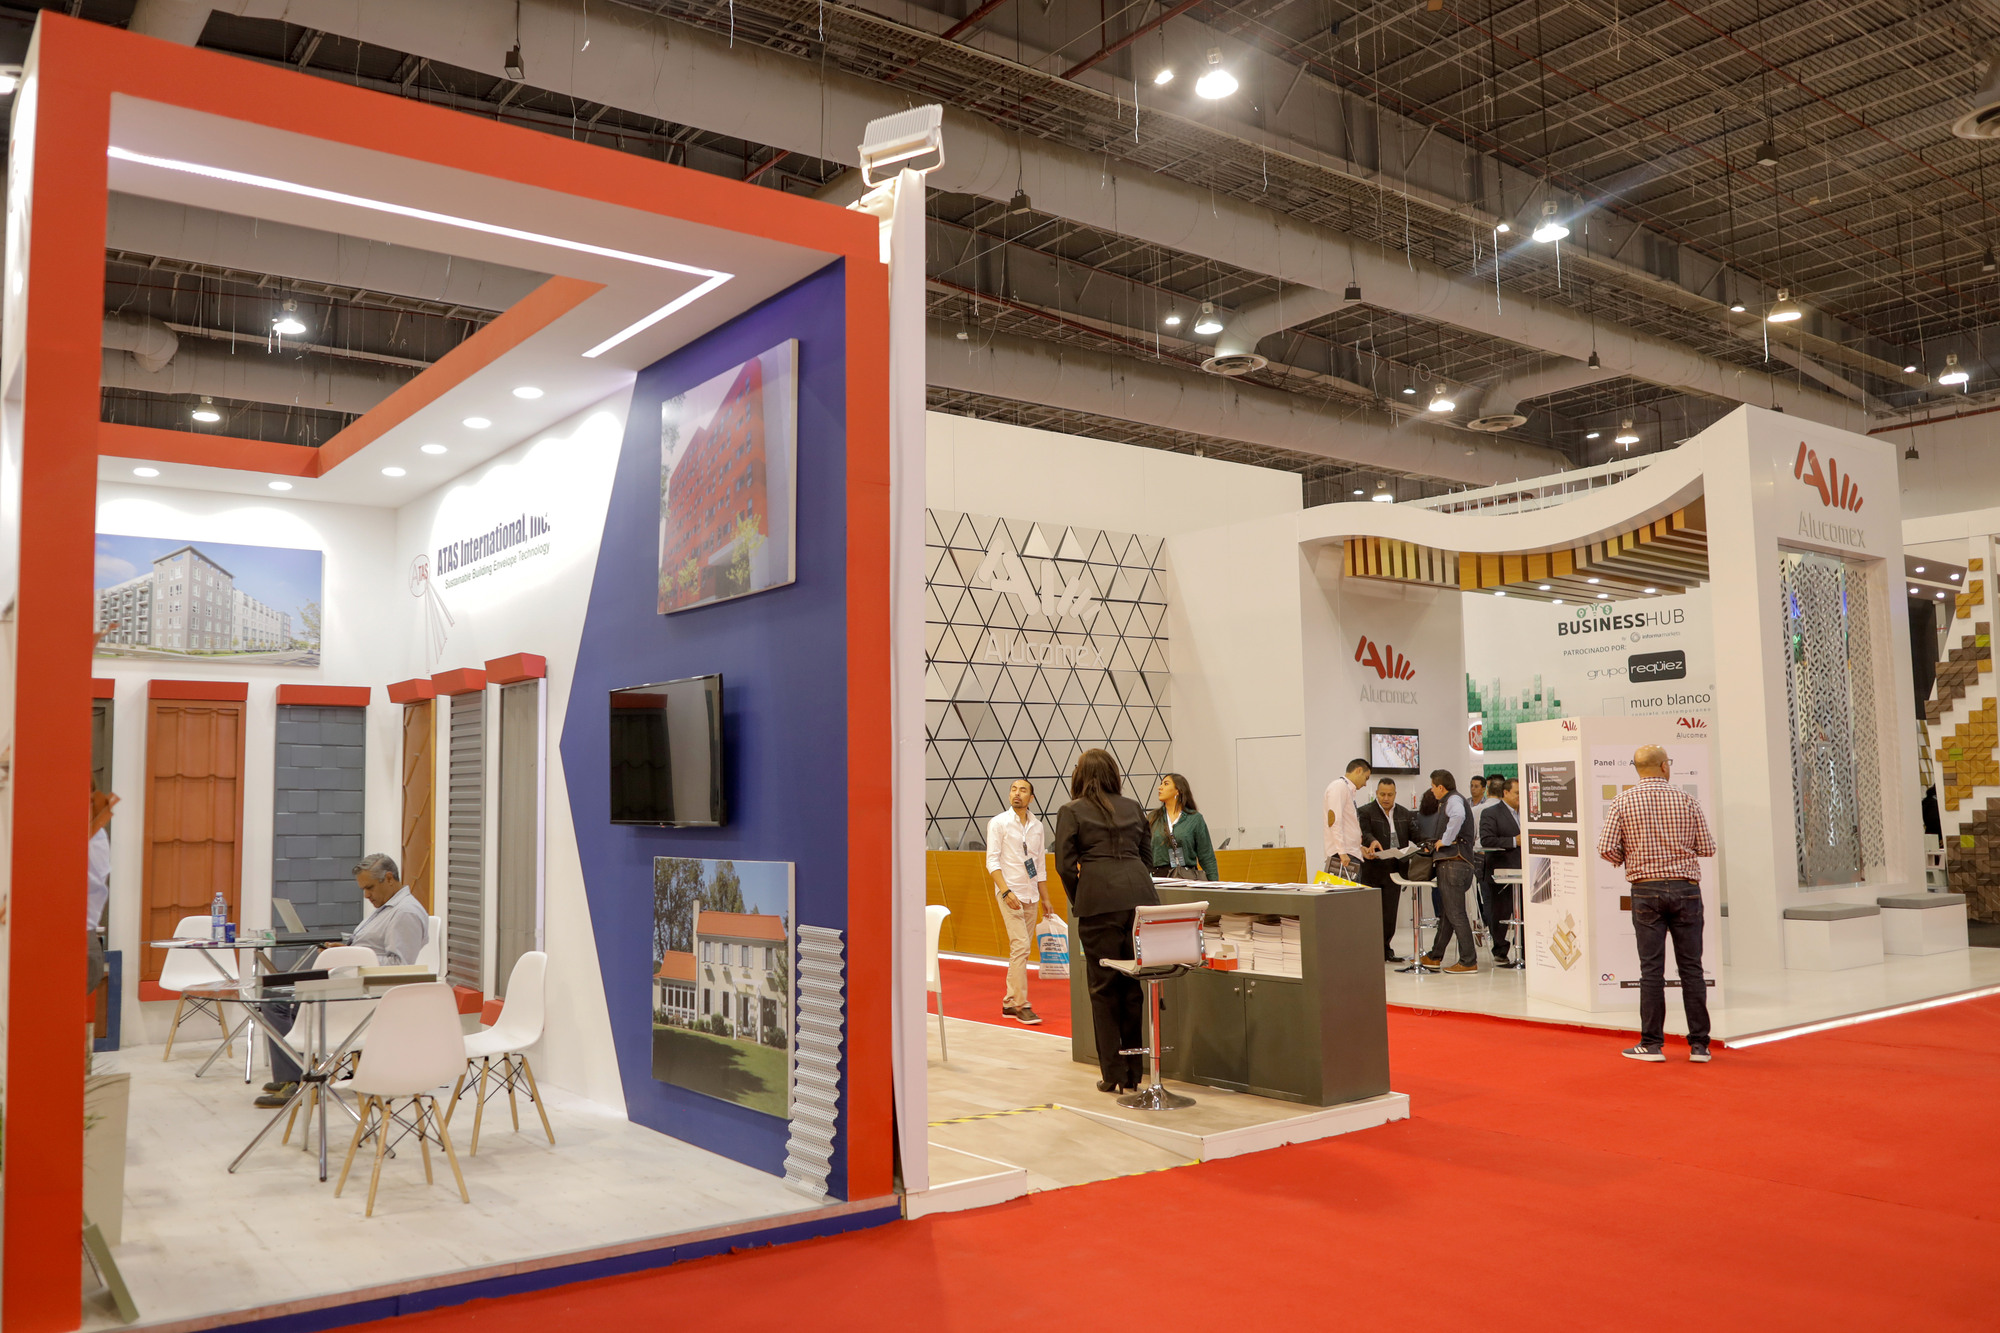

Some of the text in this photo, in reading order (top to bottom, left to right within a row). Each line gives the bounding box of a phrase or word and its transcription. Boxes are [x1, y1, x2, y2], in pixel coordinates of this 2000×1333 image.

[1798, 511, 1866, 549] Alucomex
[437, 541, 459, 576] ATAS
[461, 512, 528, 567] International,
[445, 541, 551, 590] Sustainable Building Envelope Technology
[1557, 608, 1685, 636] BUSINESSHUB
[983, 632, 1107, 668] Alucomex
[1563, 643, 1627, 656] PATROCINADO POR:
[1587, 660, 1684, 681] grupo reqüiez
[1360, 684, 1418, 705] Alucomex
[1630, 693, 1711, 709] muro blanco
[1676, 732, 1708, 740] Alucomex
[1594, 759, 1615, 767] Panel
[1617, 759, 1627, 767] de
